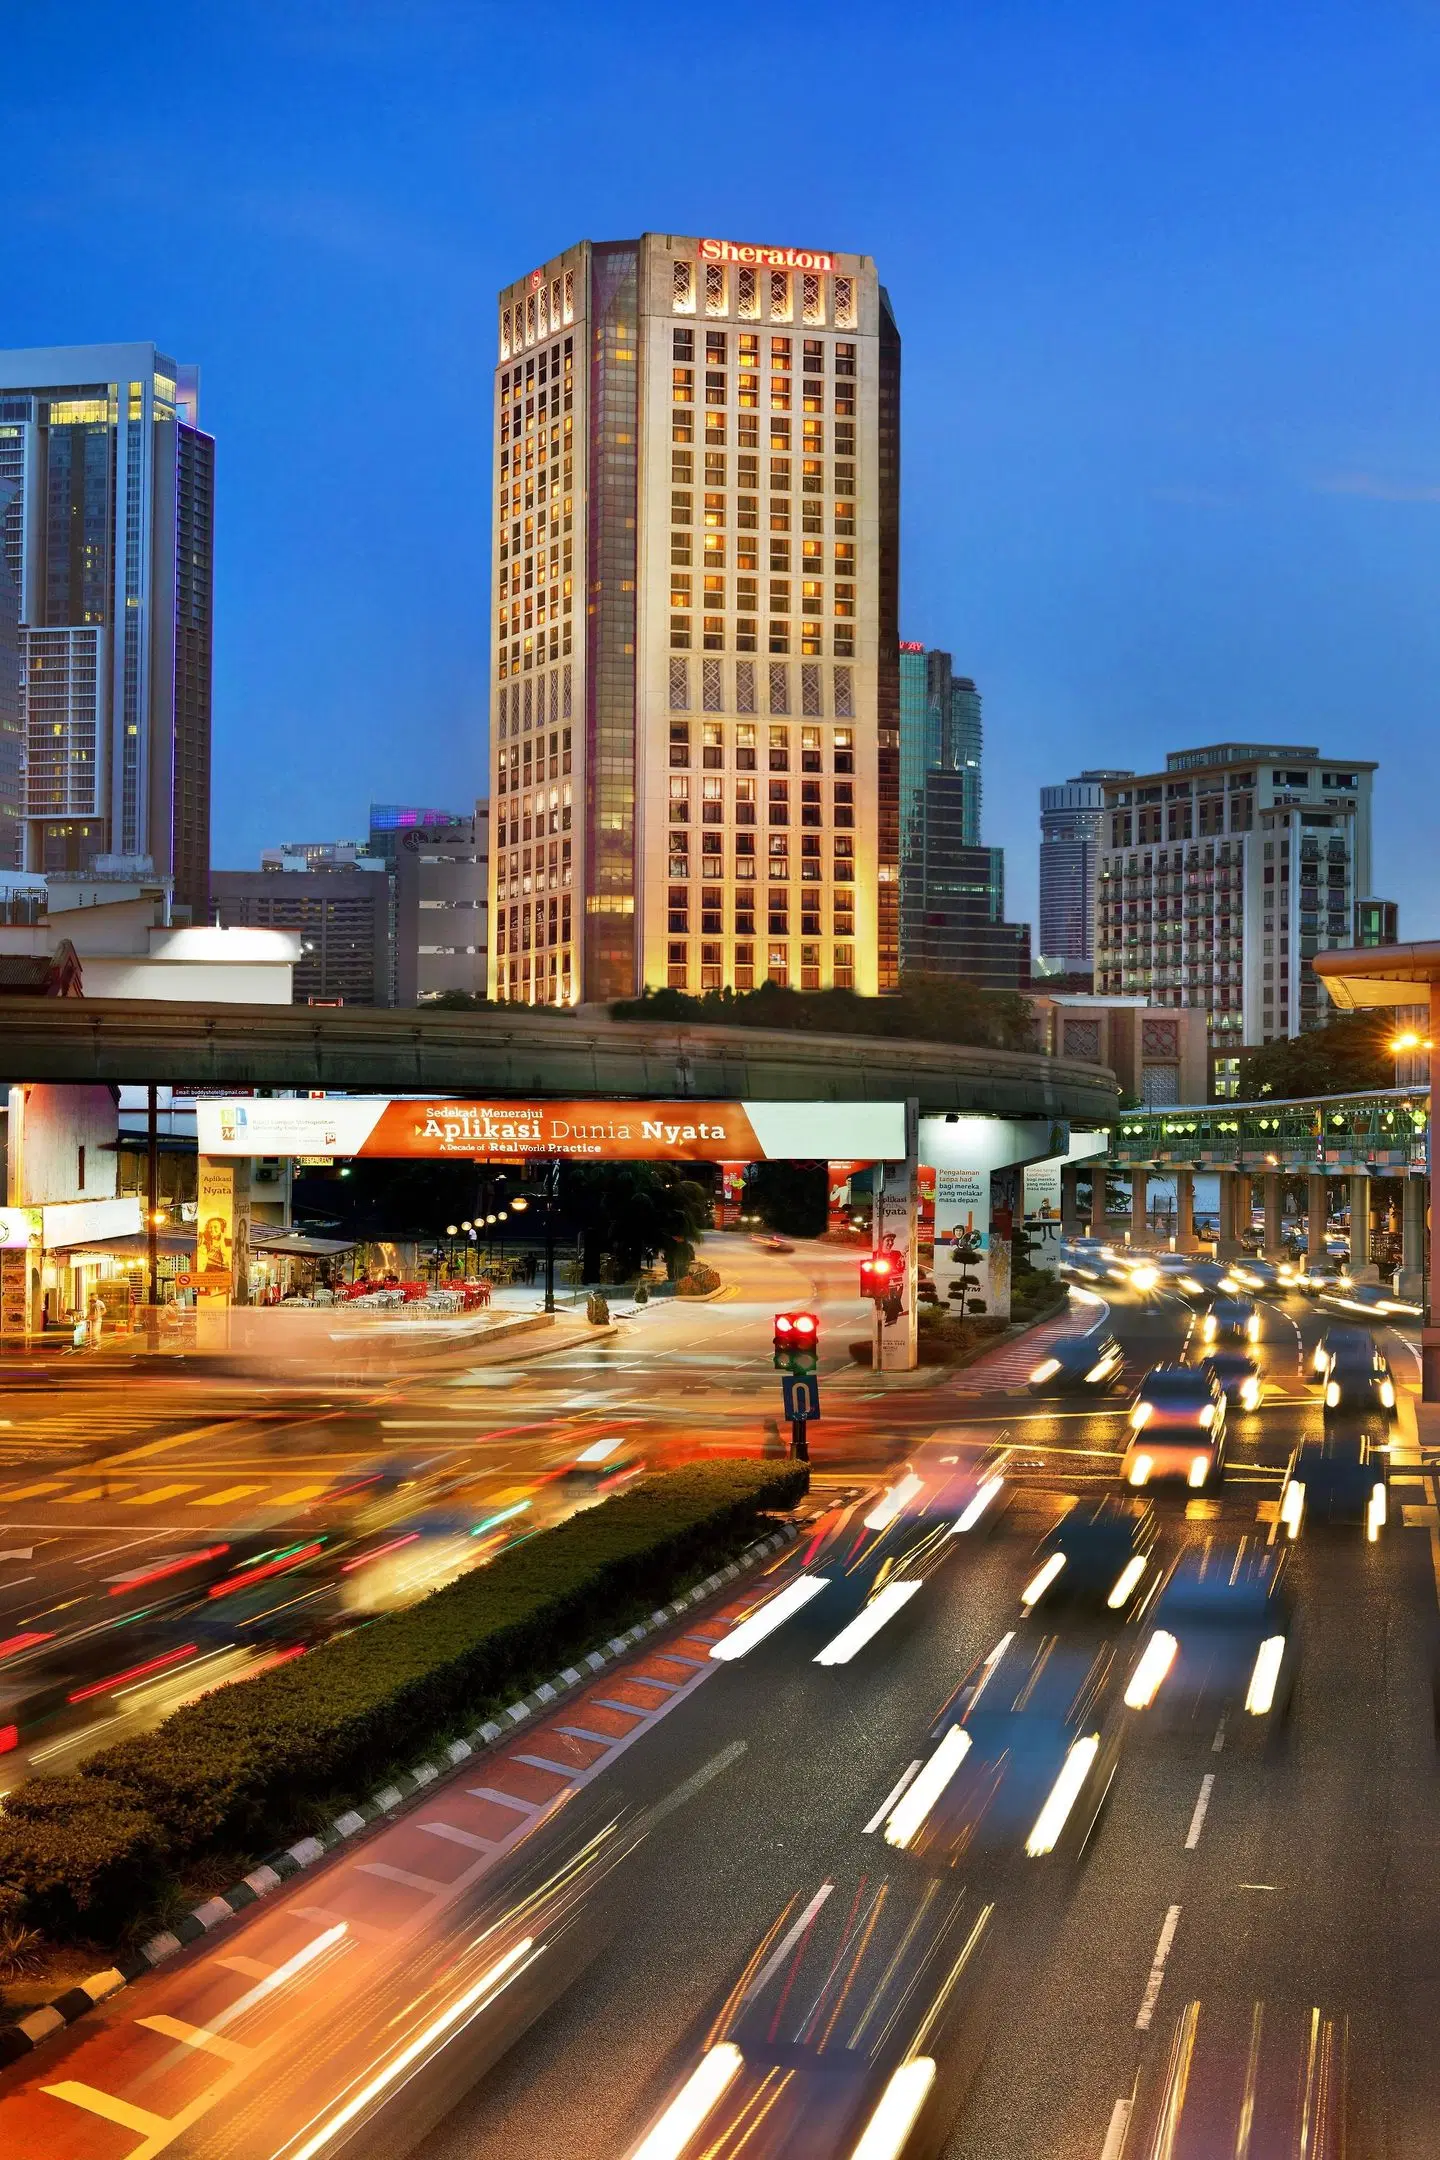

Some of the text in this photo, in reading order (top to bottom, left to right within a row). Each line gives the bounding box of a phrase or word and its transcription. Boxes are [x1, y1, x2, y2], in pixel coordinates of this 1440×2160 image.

[702, 239, 832, 270] Sheraton
[426, 1107, 543, 1120] Sedekad Menerajui
[422, 1117, 726, 1144] Aplikasi Dunia Nyata
[447, 1143, 475, 1151] Decade
[476, 1143, 485, 1151] of
[489, 1142, 518, 1152] Real
[520, 1144, 546, 1152] World
[547, 1143, 601, 1153] Practice
[301, 1157, 333, 1165] RESTAURANT
[203, 1186, 232, 1196] Nyata
